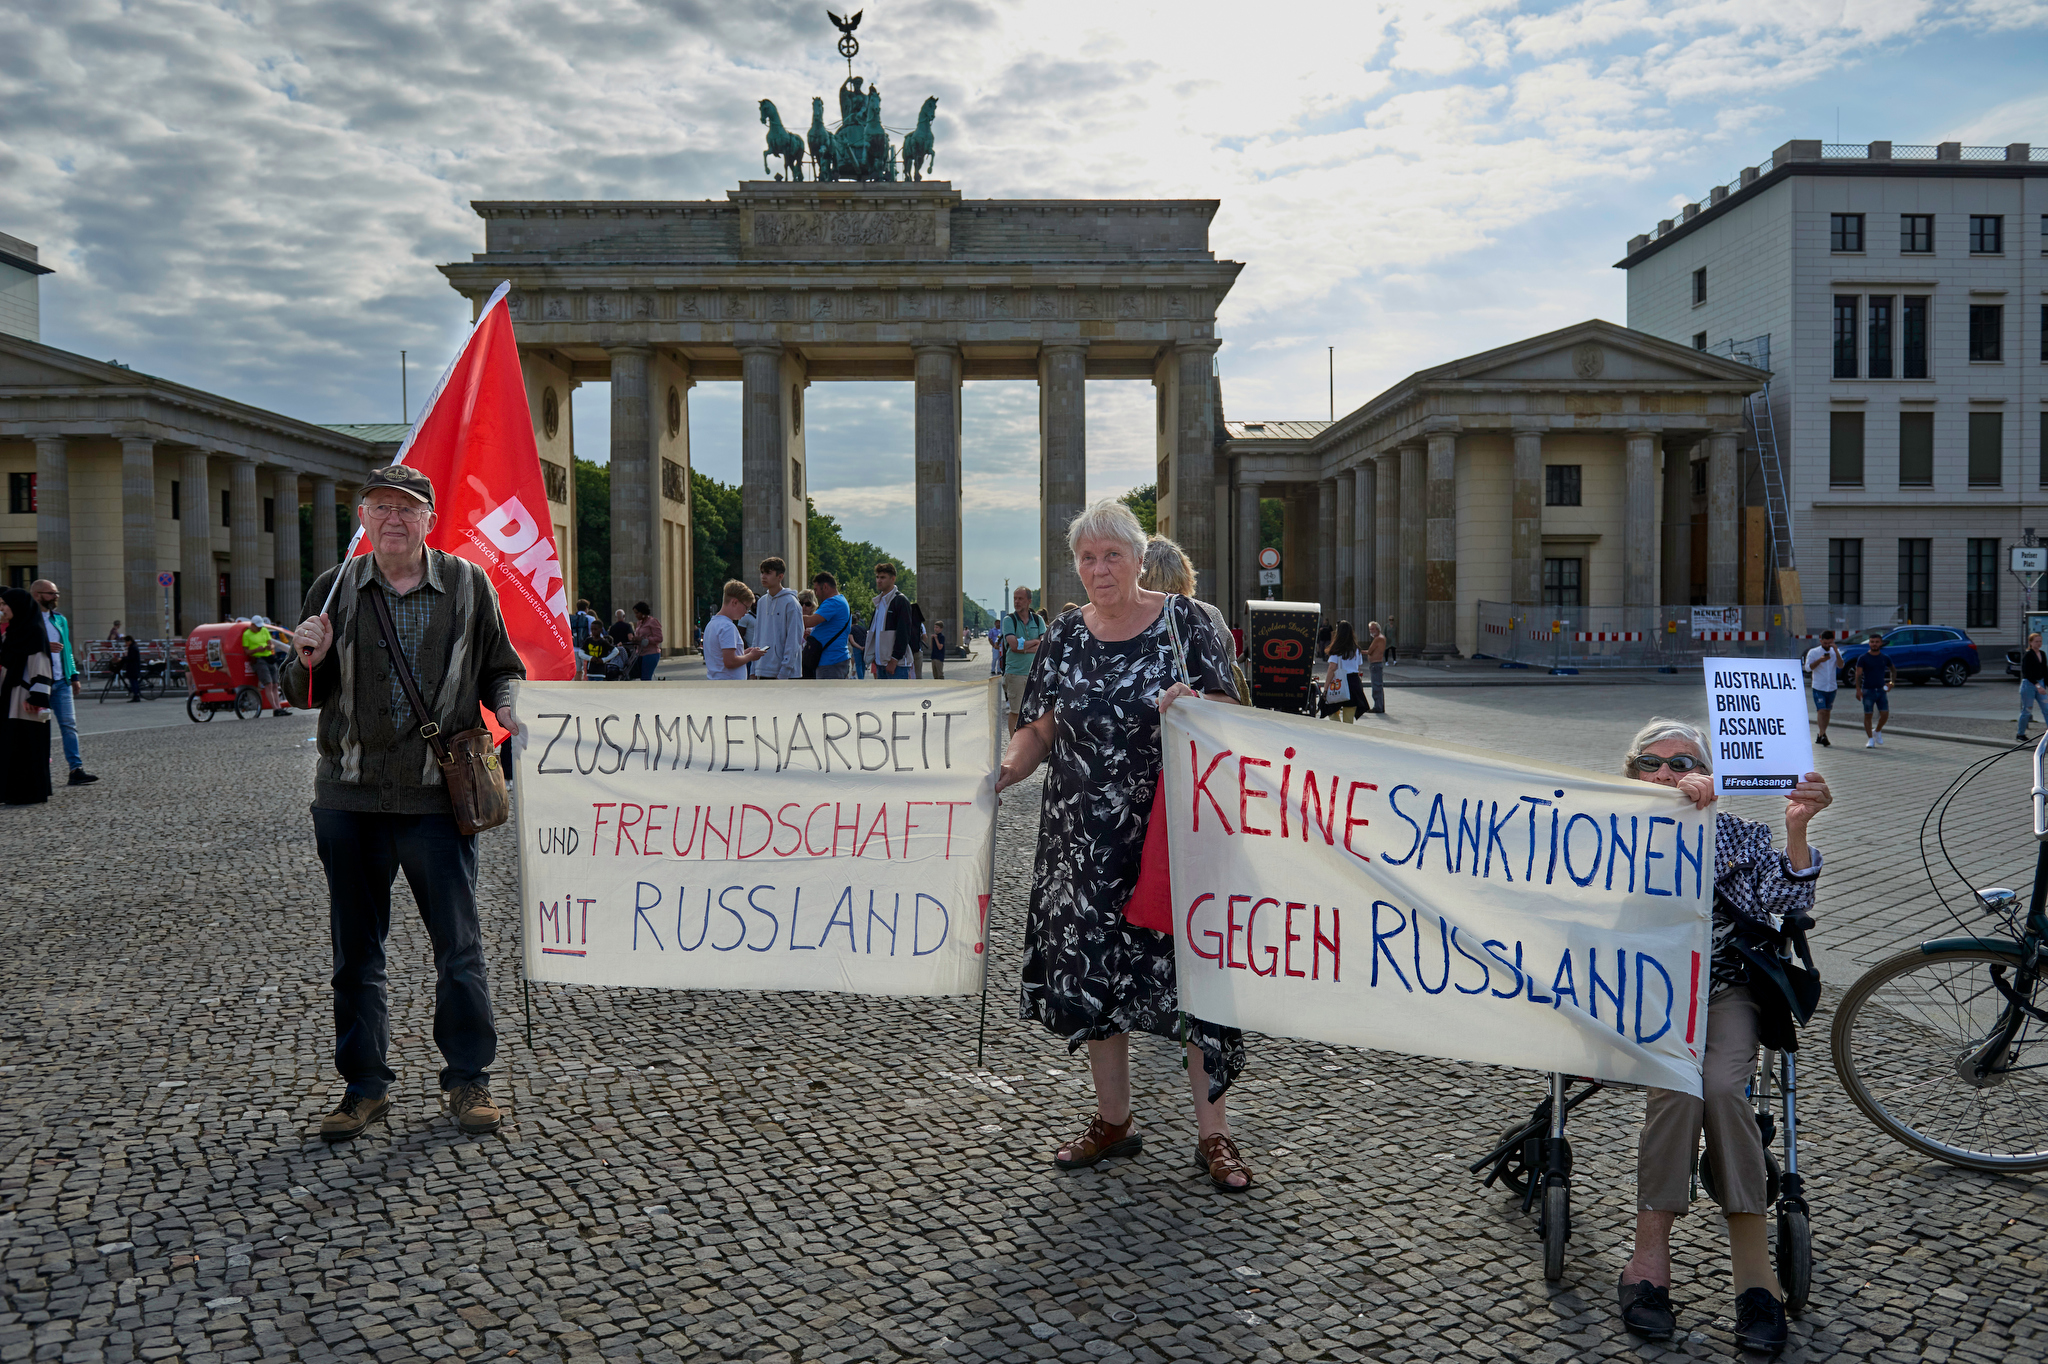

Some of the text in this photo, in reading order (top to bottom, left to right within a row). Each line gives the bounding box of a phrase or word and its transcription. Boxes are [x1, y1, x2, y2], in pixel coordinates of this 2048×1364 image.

[465, 529, 568, 650] Deutsche Kommunistische Partei
[1258, 622, 1309, 638] Golden Dolls
[1259, 665, 1304, 675] Tabledance
[1273, 675, 1289, 683] Bar
[1714, 671, 1797, 690] AUSTRALIA:
[1716, 694, 1761, 712] BRING
[1719, 718, 1786, 735] ASSANGE
[1720, 741, 1764, 760] HOME
[1724, 777, 1792, 787] #FreeAssange
[538, 801, 972, 860] UND FREUNDSCHAFT
[1186, 892, 1341, 982] GEGEN
